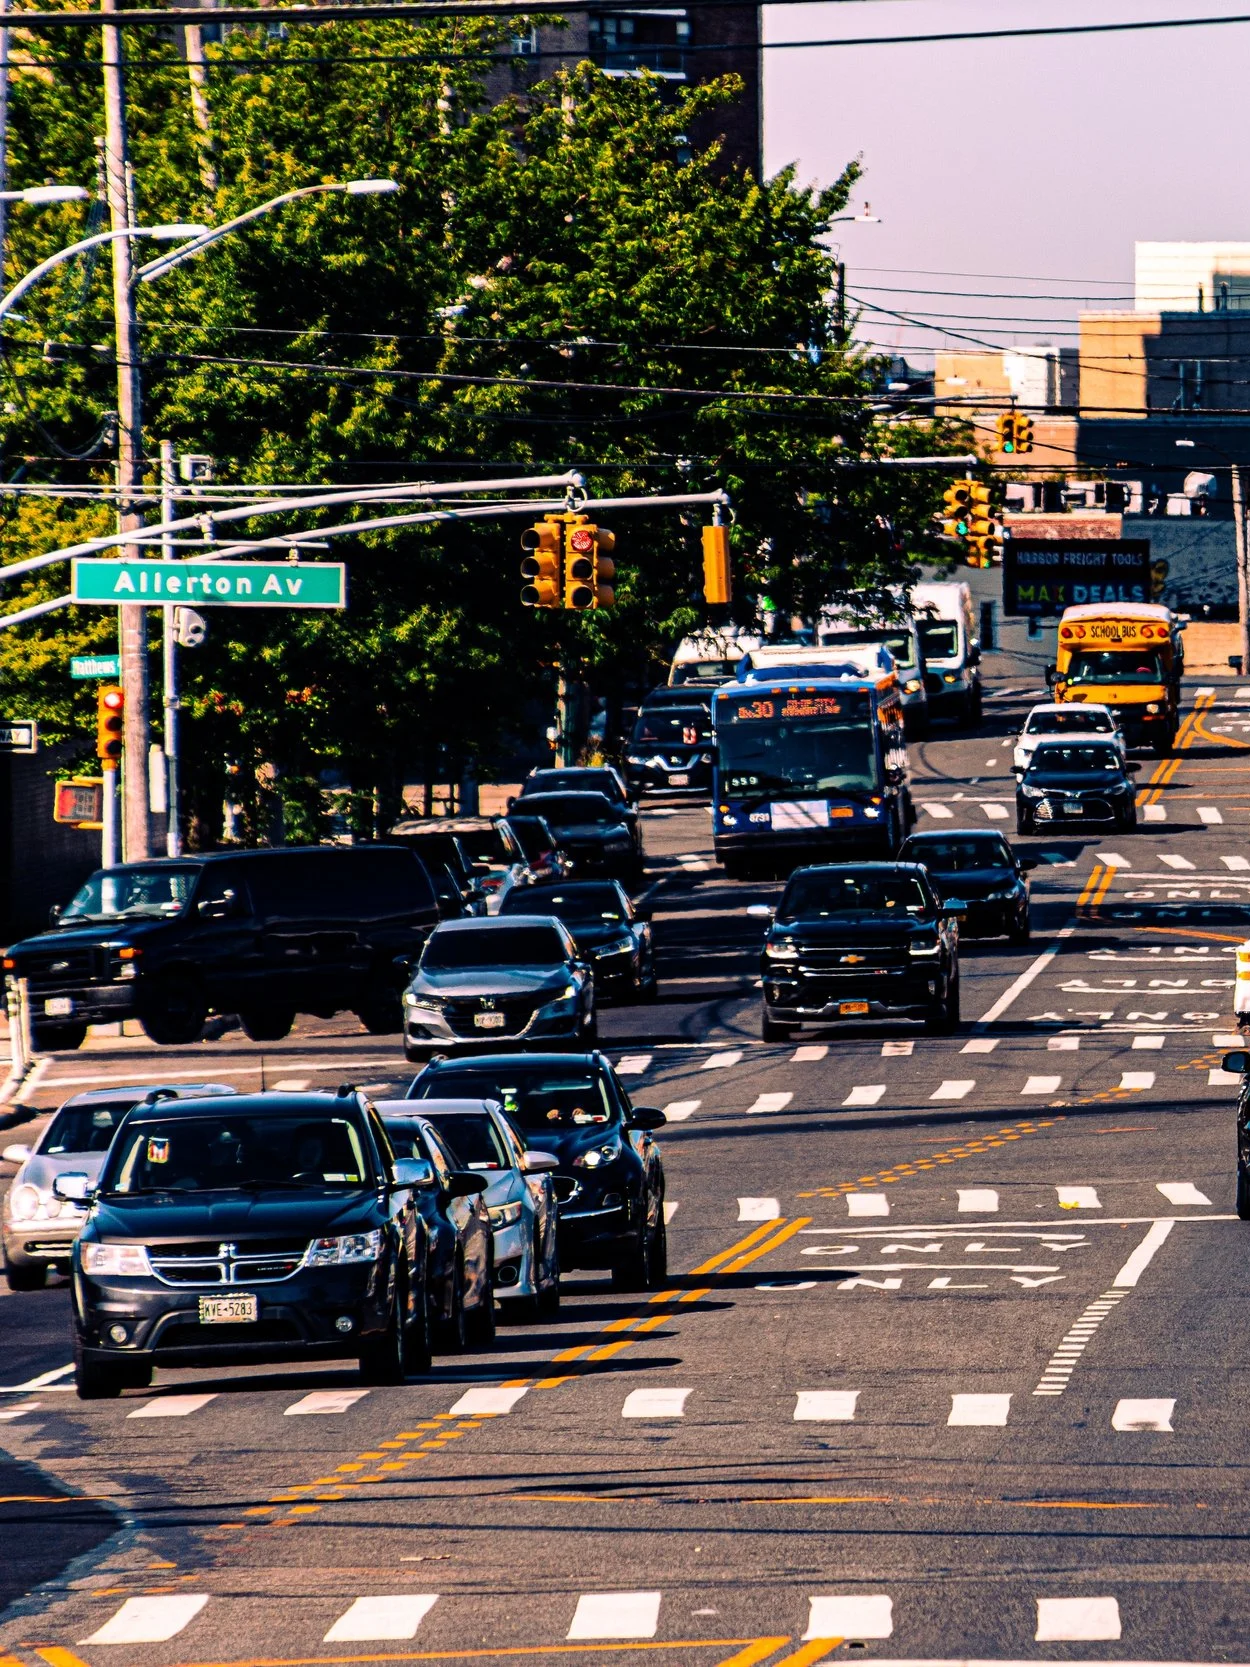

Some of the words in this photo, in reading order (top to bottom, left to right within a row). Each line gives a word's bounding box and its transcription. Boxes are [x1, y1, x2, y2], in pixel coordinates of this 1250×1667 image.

[1016, 551, 1060, 565] HARBOR
[1063, 552, 1107, 566] FREIGHT
[1111, 552, 1144, 565] TOOLS
[113, 570, 252, 595] Allerton
[262, 573, 303, 596] Av
[1017, 584, 1065, 602] MAX
[1073, 584, 1144, 602] DEALS
[1090, 624, 1121, 638] SCHOOL
[1122, 625, 1137, 638] BUS
[800, 1242, 1092, 1255] ONLY
[754, 1275, 1066, 1291] ONLY
